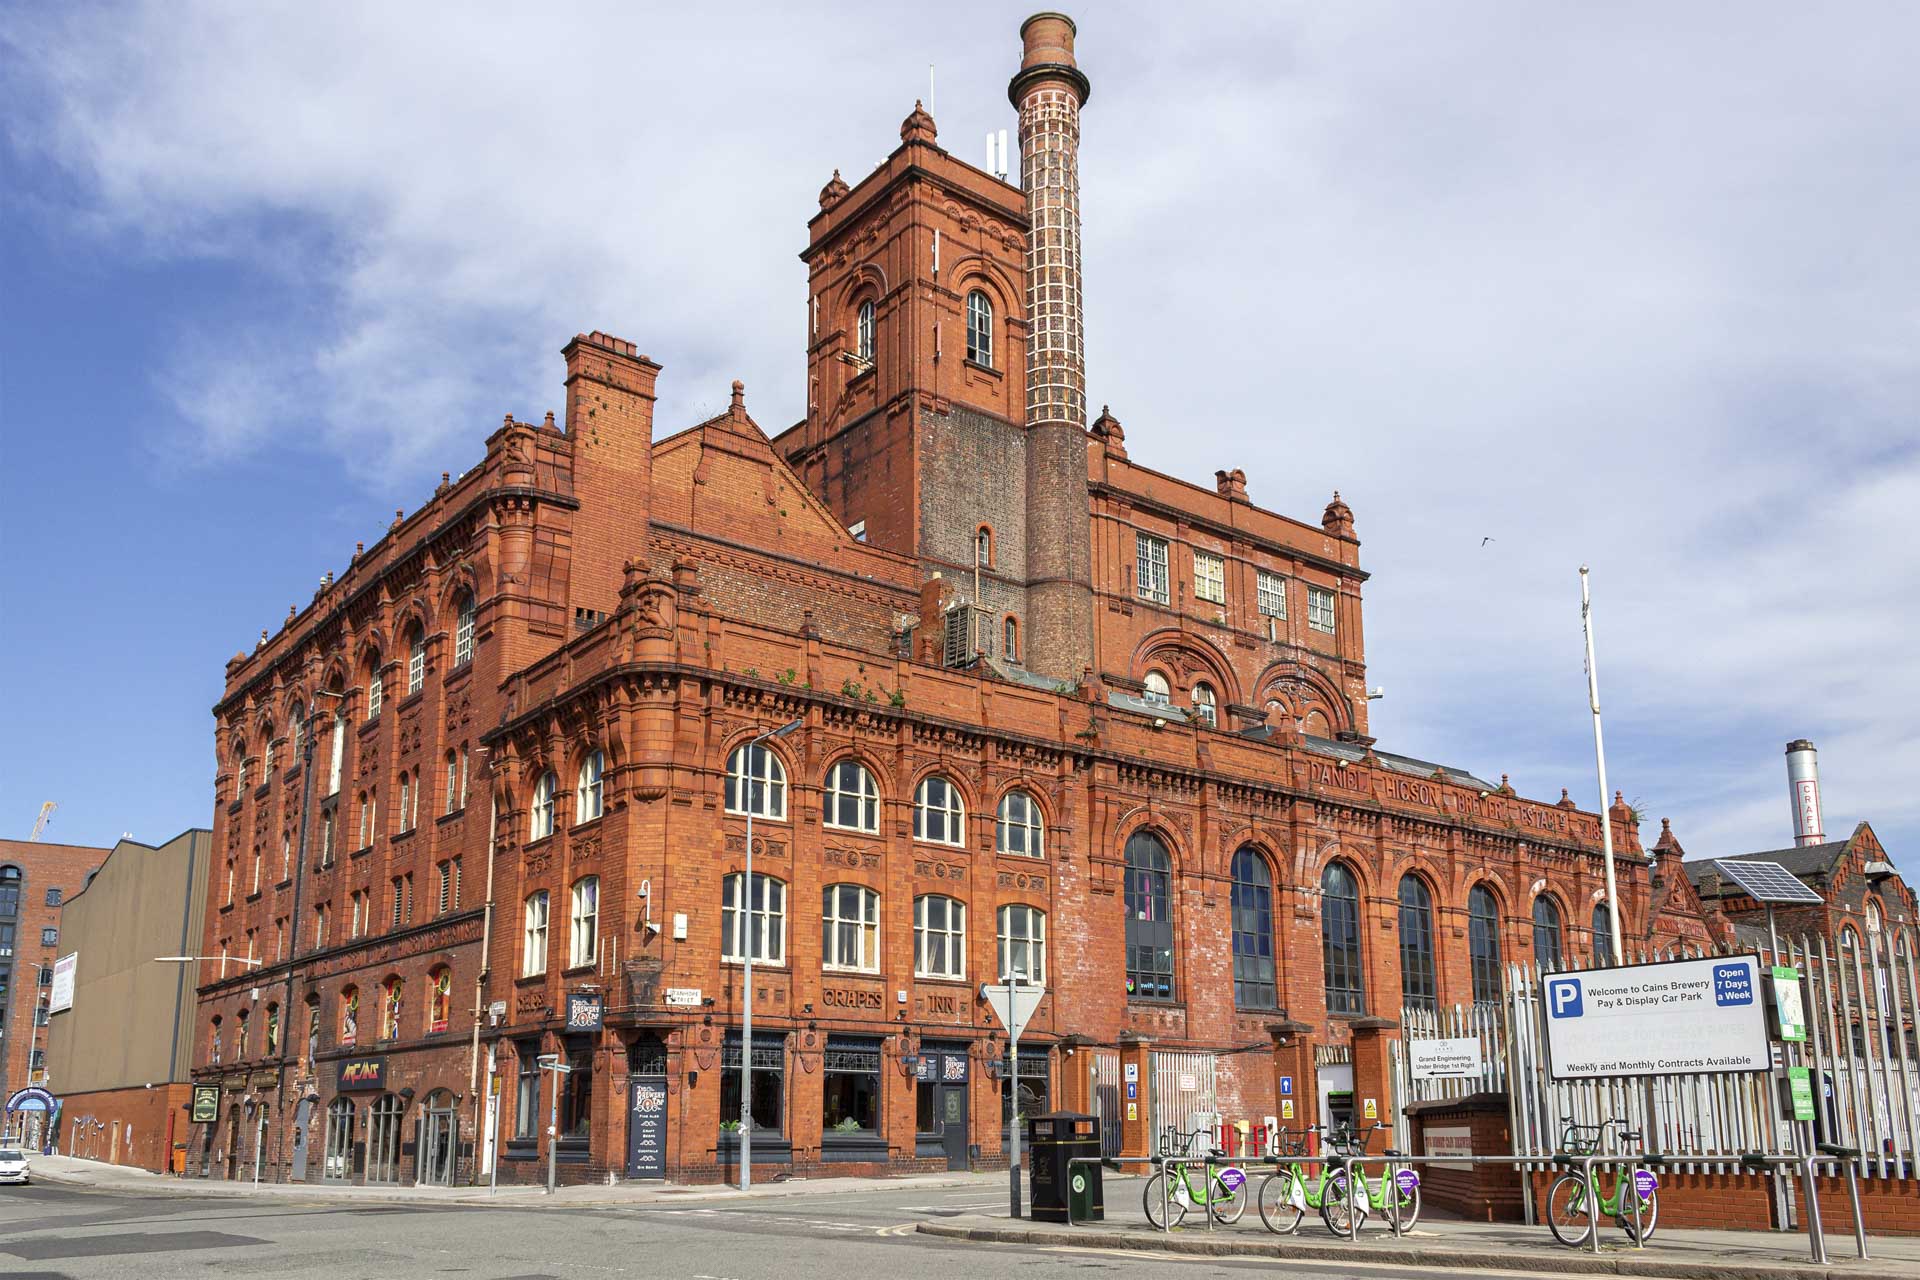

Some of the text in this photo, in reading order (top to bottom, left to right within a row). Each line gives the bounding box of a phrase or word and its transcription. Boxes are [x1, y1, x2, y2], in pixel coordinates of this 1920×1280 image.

[1804, 785, 1814, 833] CRAFT
[1719, 968, 1744, 978] Open
[1588, 980, 1710, 997] Welcome to Cains Brewery
[1717, 980, 1748, 989] 7 Days
[1555, 983, 1577, 1013] P
[1597, 992, 1703, 1008] Pay & Display Car Park
[1724, 990, 1751, 999] Week
[928, 995, 956, 1014] INN
[1433, 1063, 1450, 1071] Bridge
[1567, 1056, 1751, 1073] Weekly and Monthly Contracts Available
